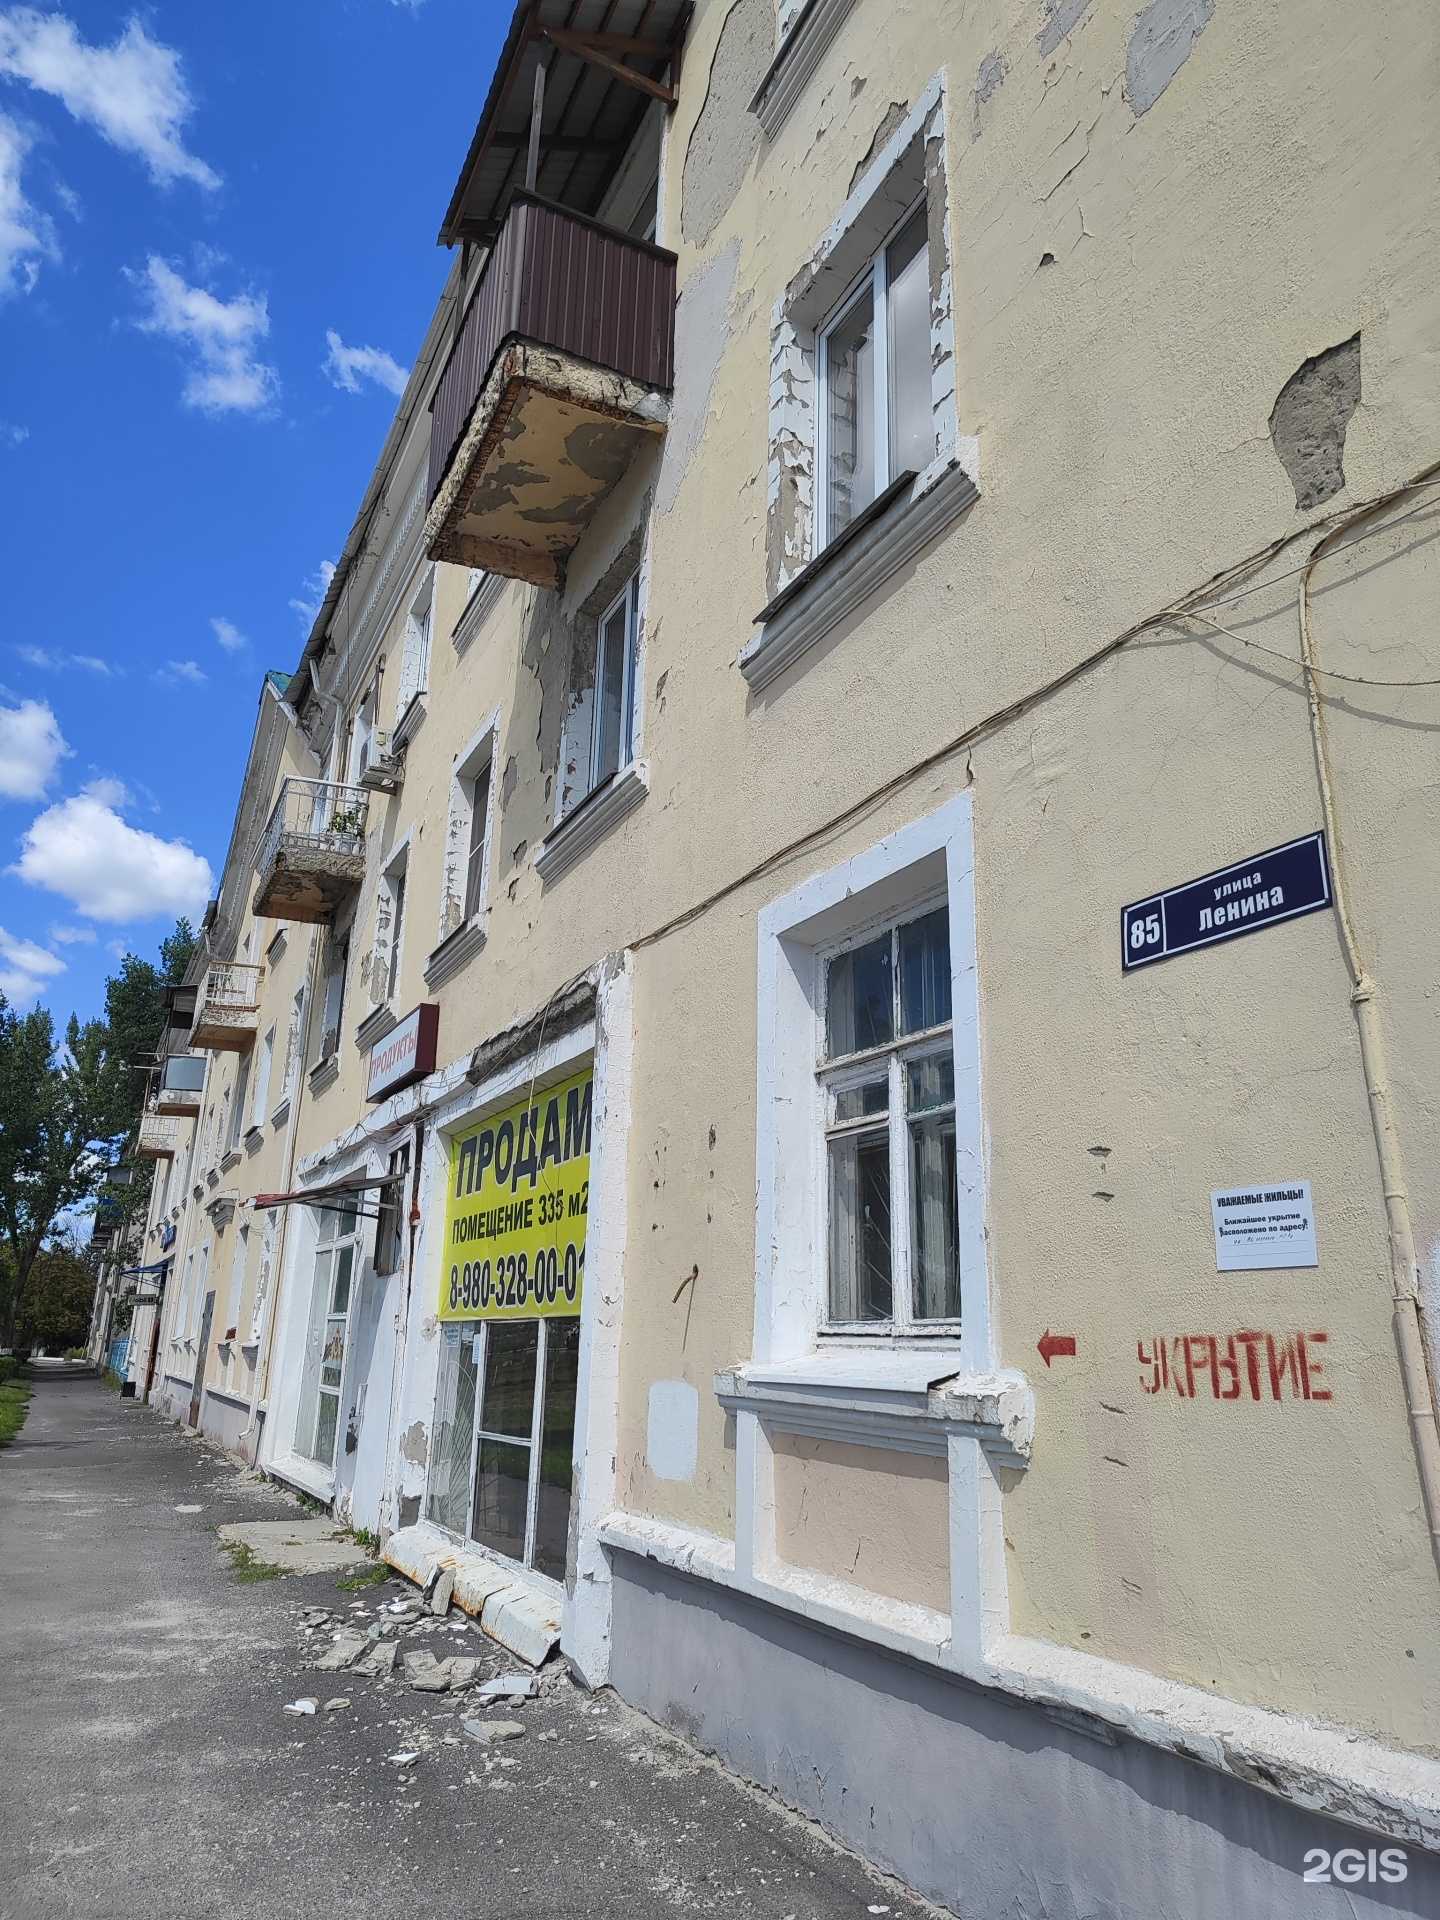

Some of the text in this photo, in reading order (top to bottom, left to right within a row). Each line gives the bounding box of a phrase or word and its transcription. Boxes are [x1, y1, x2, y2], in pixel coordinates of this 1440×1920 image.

[1198, 886, 1285, 932] Ленина
[1213, 871, 1262, 901] улица
[1130, 913, 1160, 949] 85
[371, 1026, 418, 1080] ПРОДУКТЫ
[455, 1080, 594, 1198] ПРОДАМ
[452, 1197, 534, 1245] ПОМЕЩЕНИЕ
[538, 1189, 564, 1226] 335
[1217, 1189, 1304, 1207] УВАЖАЕМЫЕ ЖИЛЬЦЫ!
[1224, 1213, 1301, 1226] Ближайшее укрытие
[1137, 1329, 1334, 1402] УКРЫТИЕ
